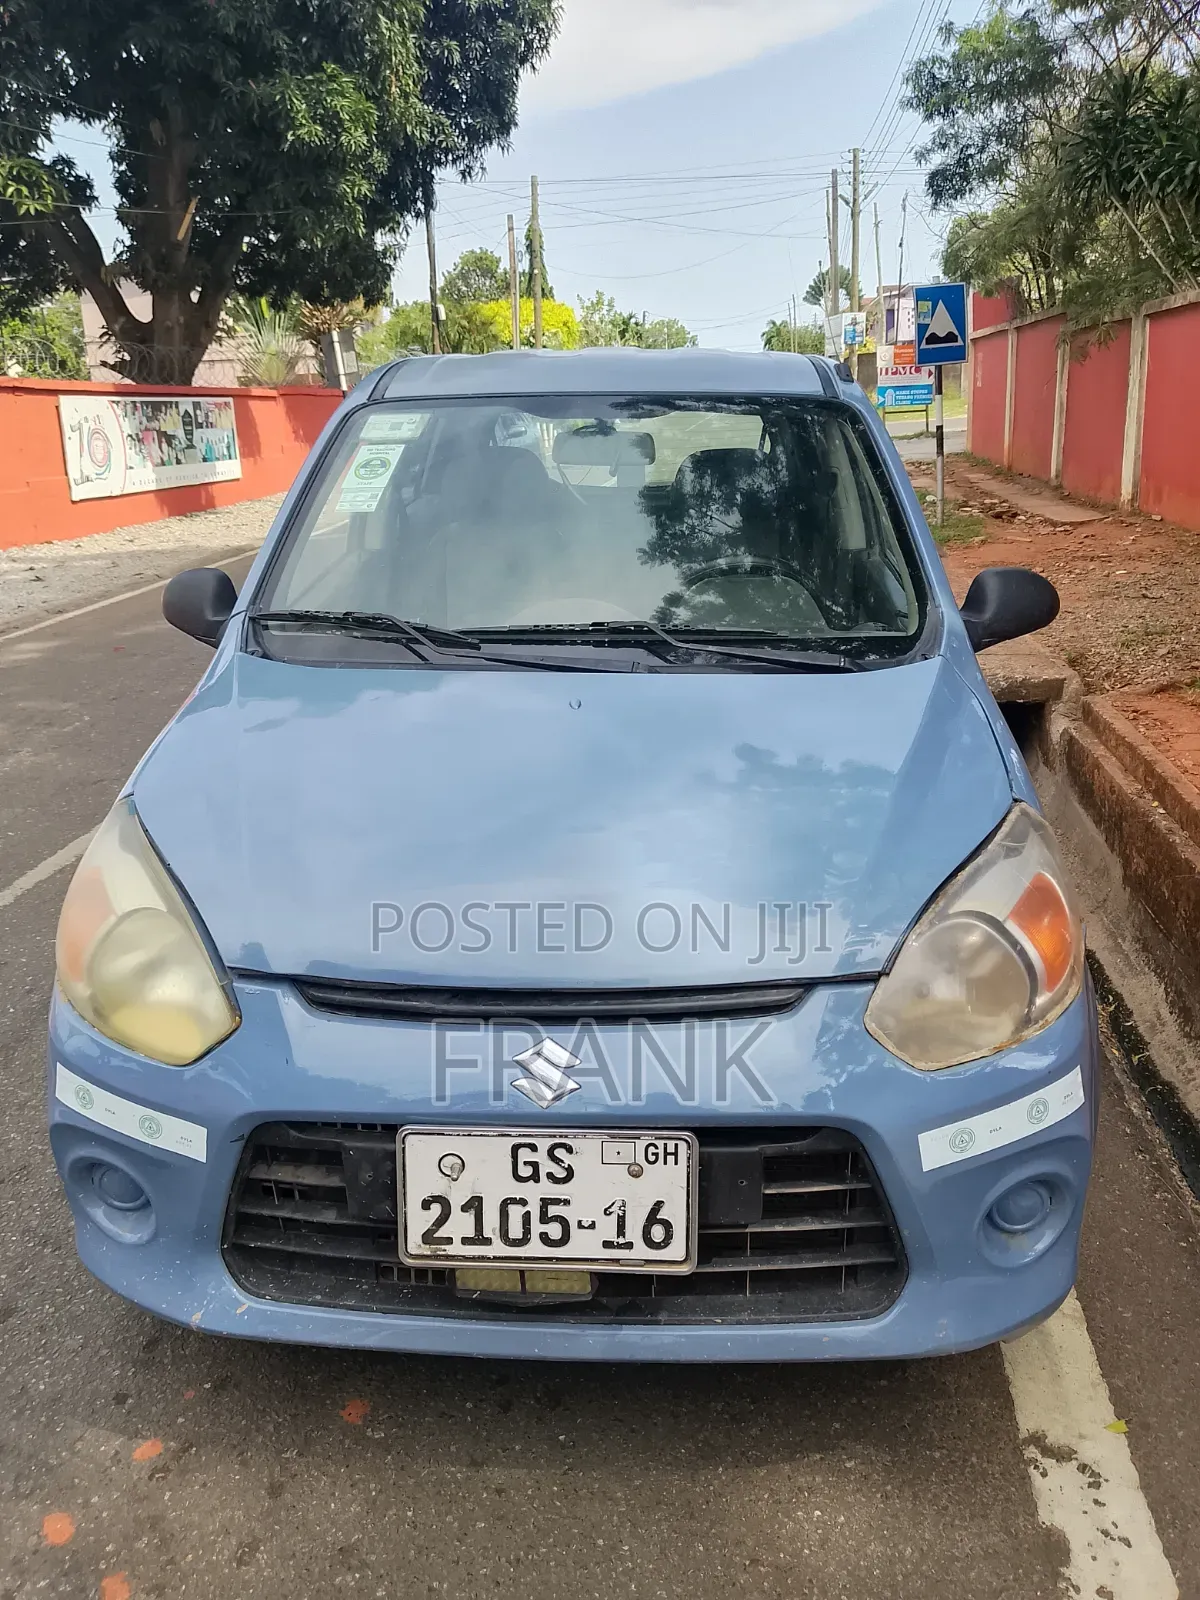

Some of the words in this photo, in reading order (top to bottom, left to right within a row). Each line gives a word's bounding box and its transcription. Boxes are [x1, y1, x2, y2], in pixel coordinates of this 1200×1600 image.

[510, 1141, 575, 1185] GS
[643, 1142, 680, 1167] GH
[420, 1194, 675, 1250] 2105-16
